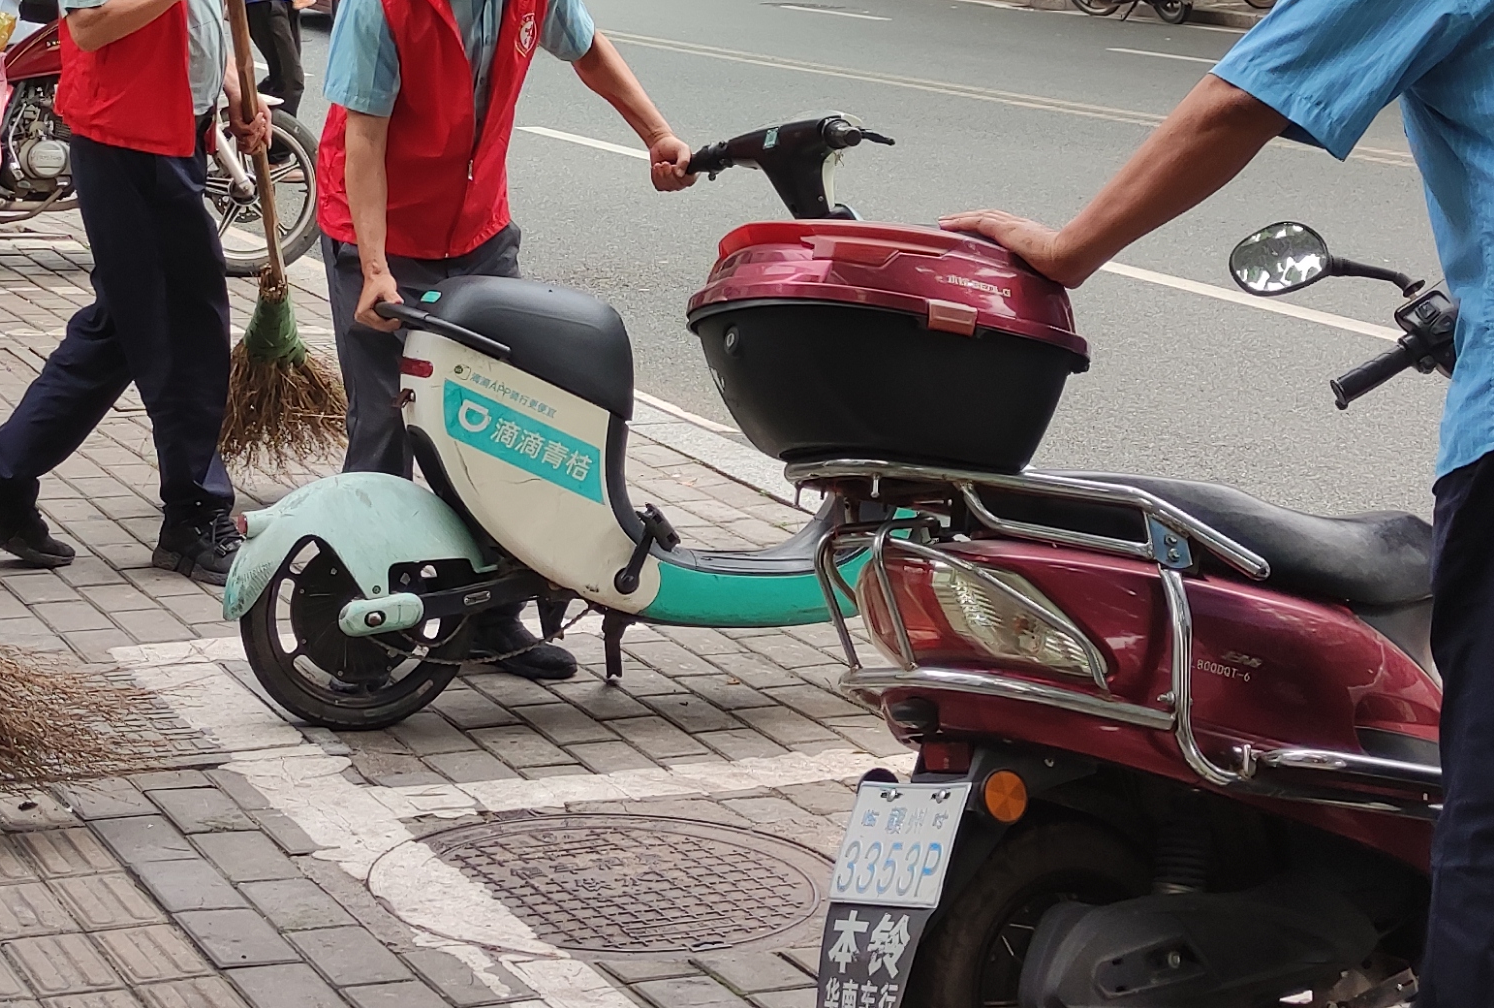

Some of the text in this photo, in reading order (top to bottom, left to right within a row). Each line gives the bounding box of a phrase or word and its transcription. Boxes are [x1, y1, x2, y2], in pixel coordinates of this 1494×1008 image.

[490, 417, 593, 482] 滴滴青桔
[837, 841, 943, 897] 3353P
[828, 910, 911, 979] 本铃
